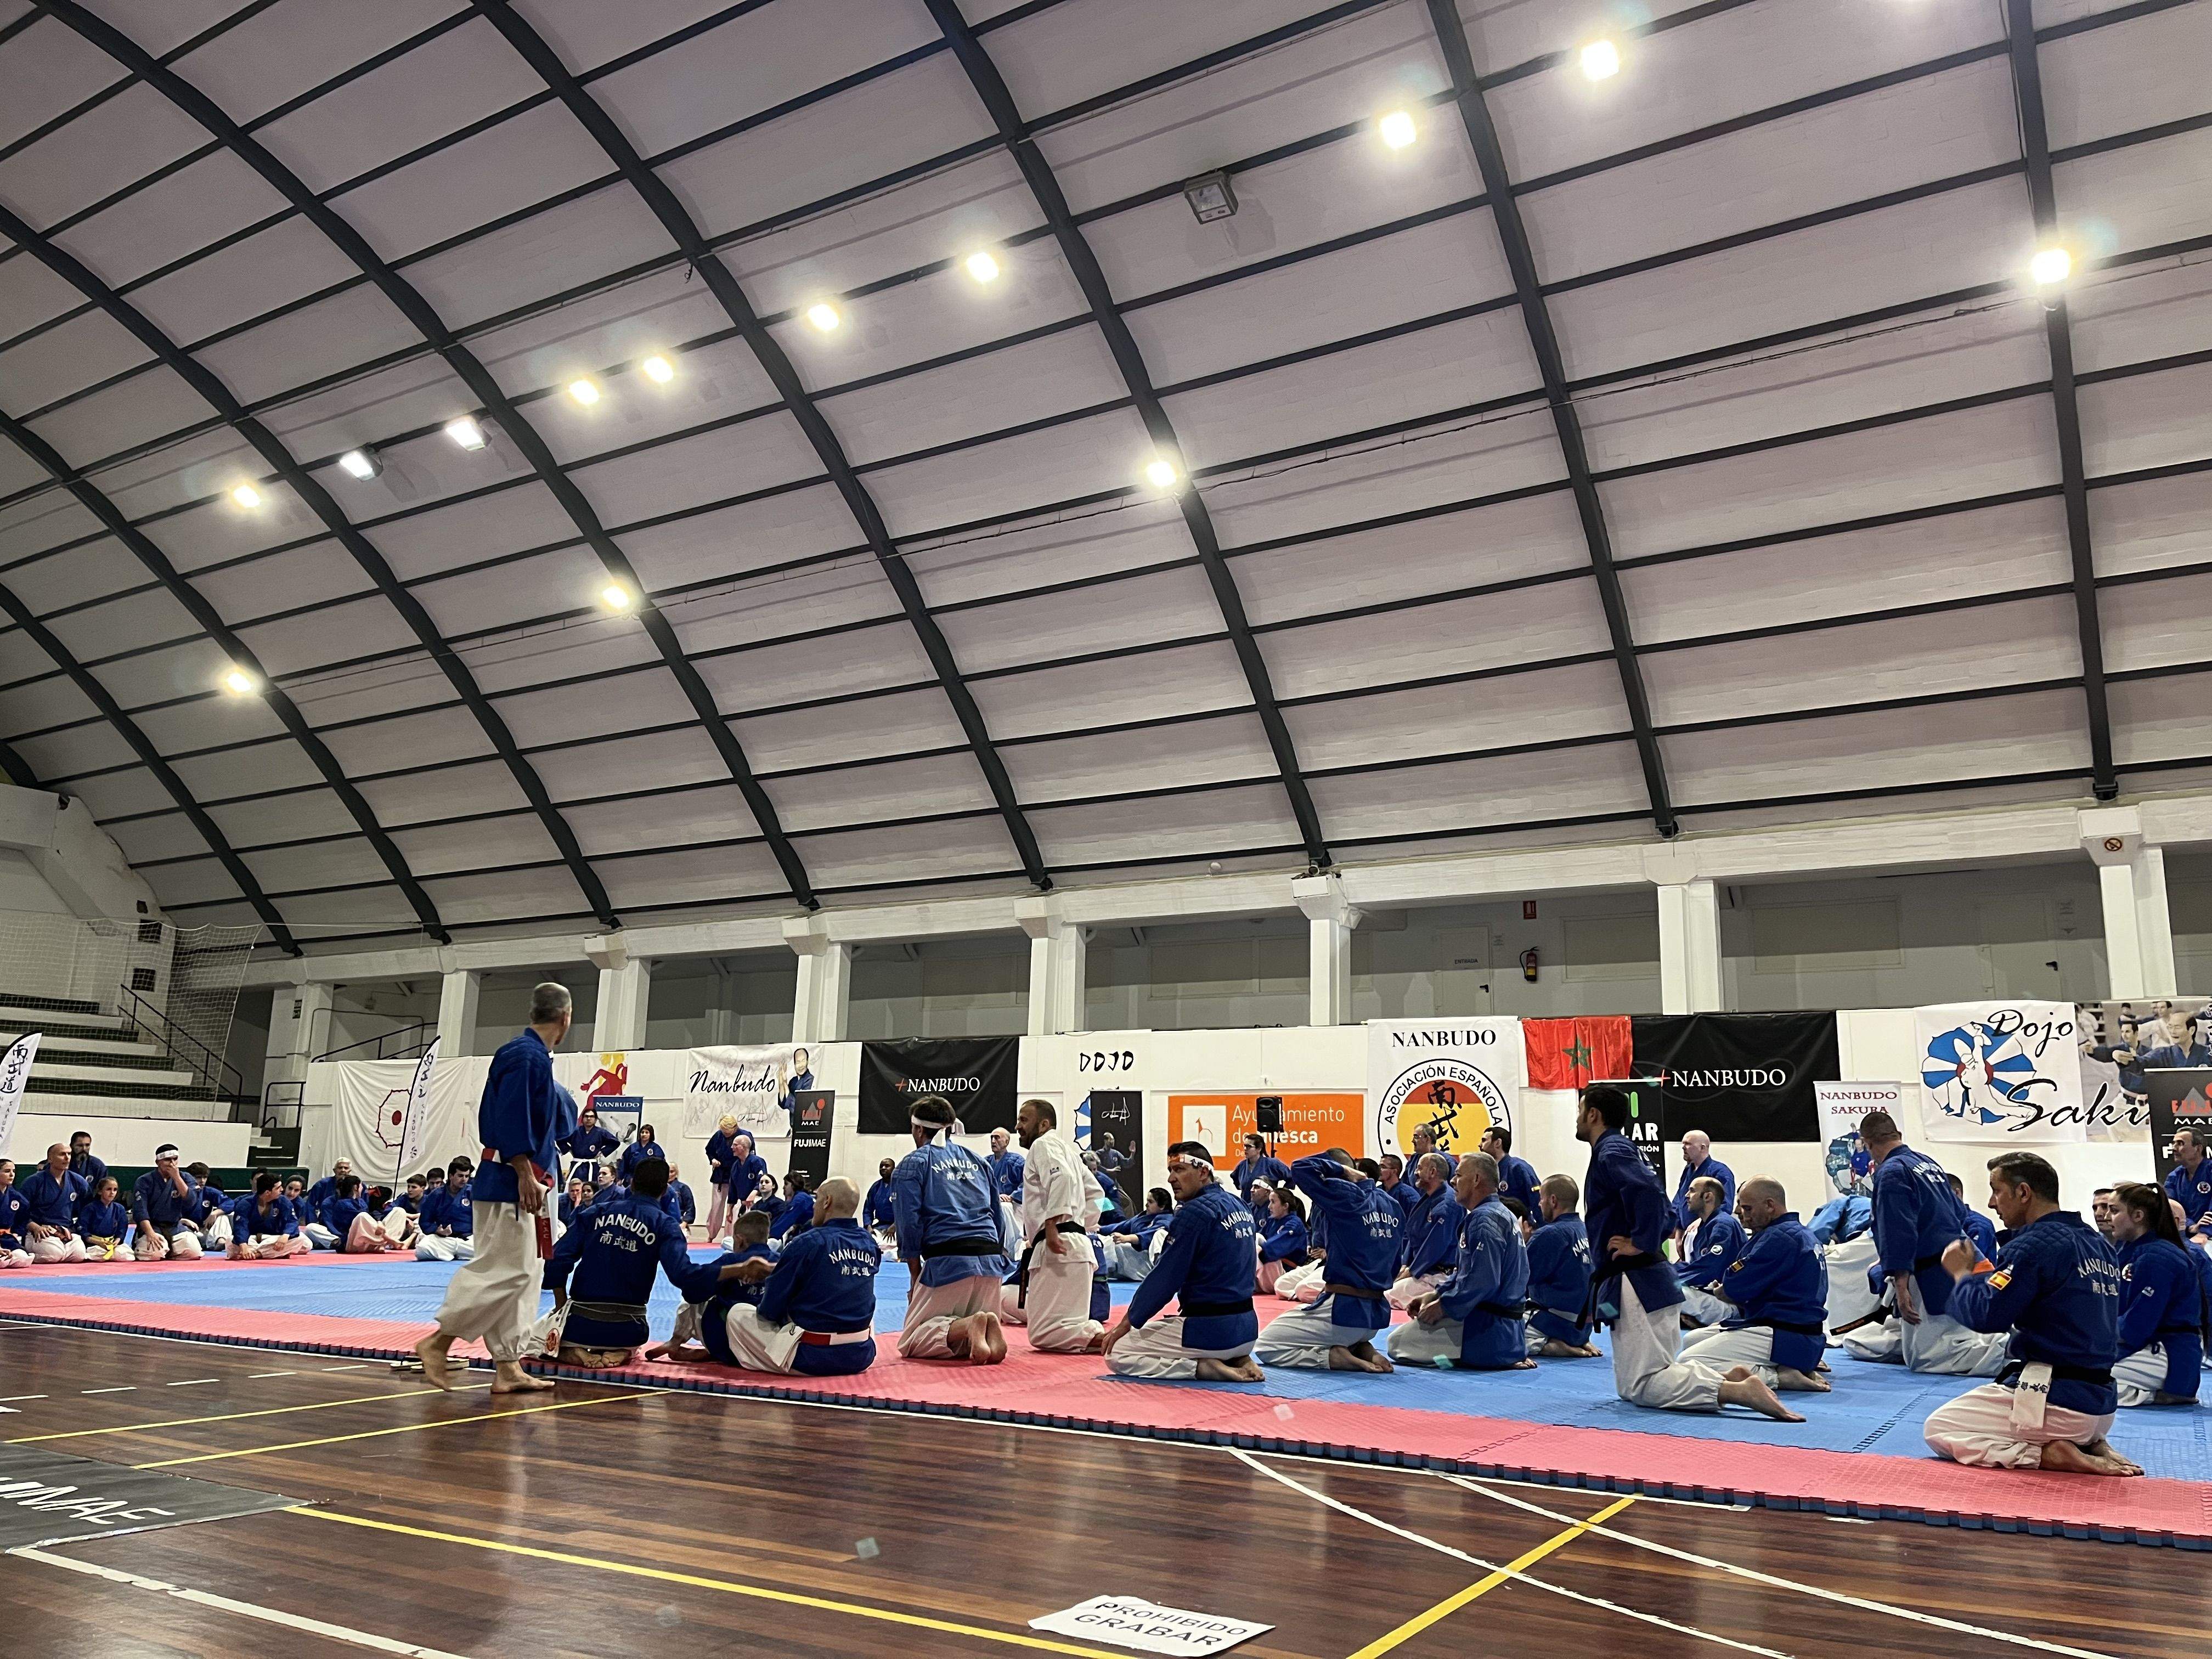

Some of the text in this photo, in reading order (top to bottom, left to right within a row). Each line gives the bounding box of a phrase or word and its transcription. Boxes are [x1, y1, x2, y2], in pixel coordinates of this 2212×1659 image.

[1392, 1030, 1496, 1047] NANBUDO
[1987, 1009, 2074, 1058] Dojo
[1080, 1051, 1134, 1071] DOJO
[690, 1064, 775, 1093] Nanbudo
[1385, 1065, 1503, 1126] ASOCIACIÓN ESPAÑOLA
[1232, 1105, 1345, 1126] Ayumiento
[1831, 1106, 1889, 1115] SAKURA
[794, 1138, 826, 1147] FUJIMAE
[594, 1214, 656, 1245] NANBUDO
[828, 1249, 875, 1266] NANBUDO
[1074, 1614, 1223, 1646] GRABAR
[1094, 1602, 1248, 1635] PROHIBIDO
